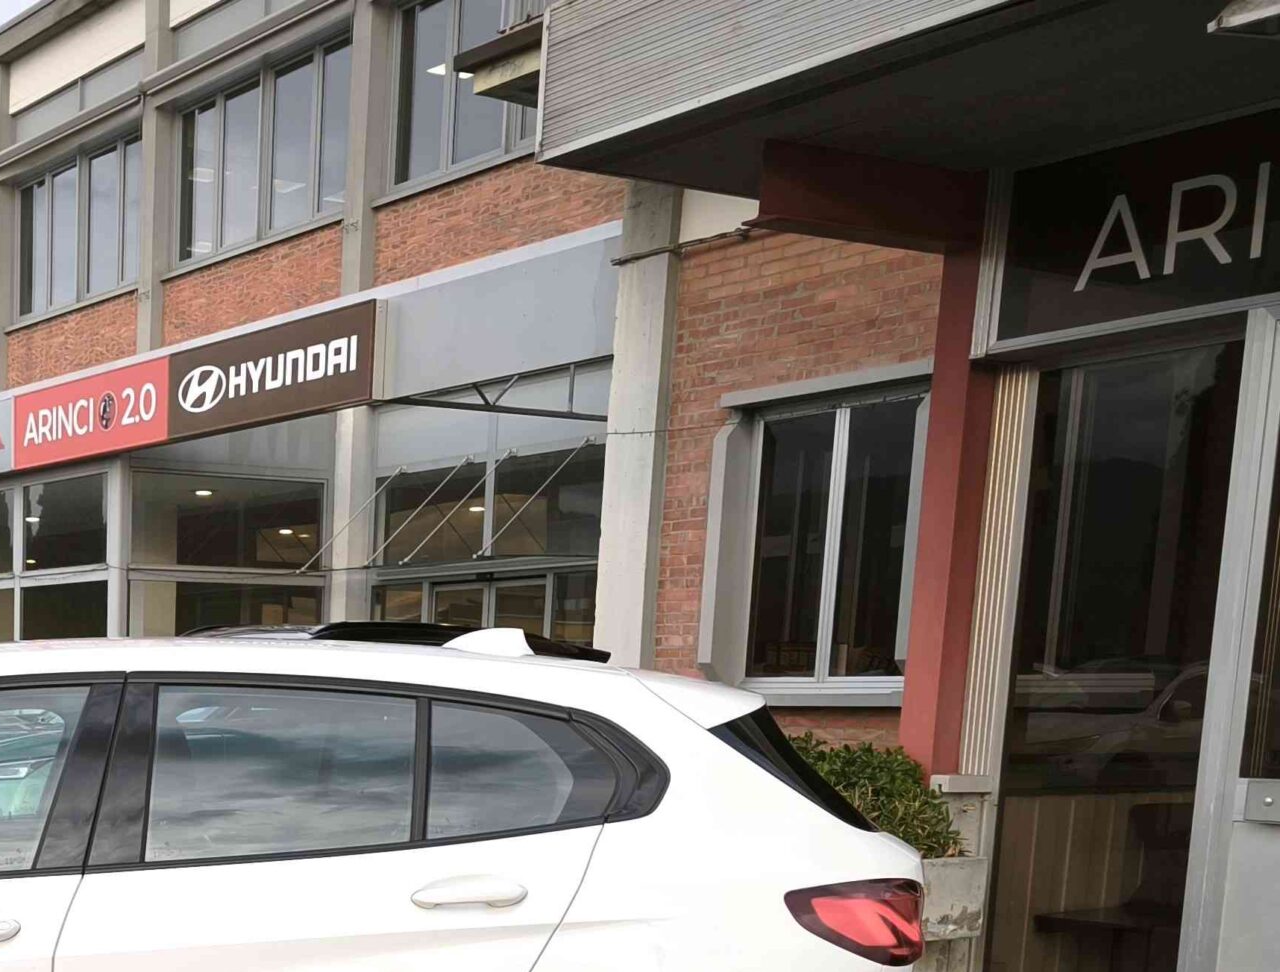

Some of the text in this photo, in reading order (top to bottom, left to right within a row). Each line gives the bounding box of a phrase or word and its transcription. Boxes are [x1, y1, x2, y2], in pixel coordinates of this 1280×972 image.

[1072, 161, 1272, 293] ARI
[227, 334, 358, 399] HYUNDAI
[22, 381, 157, 448] ARINCI 2.0
